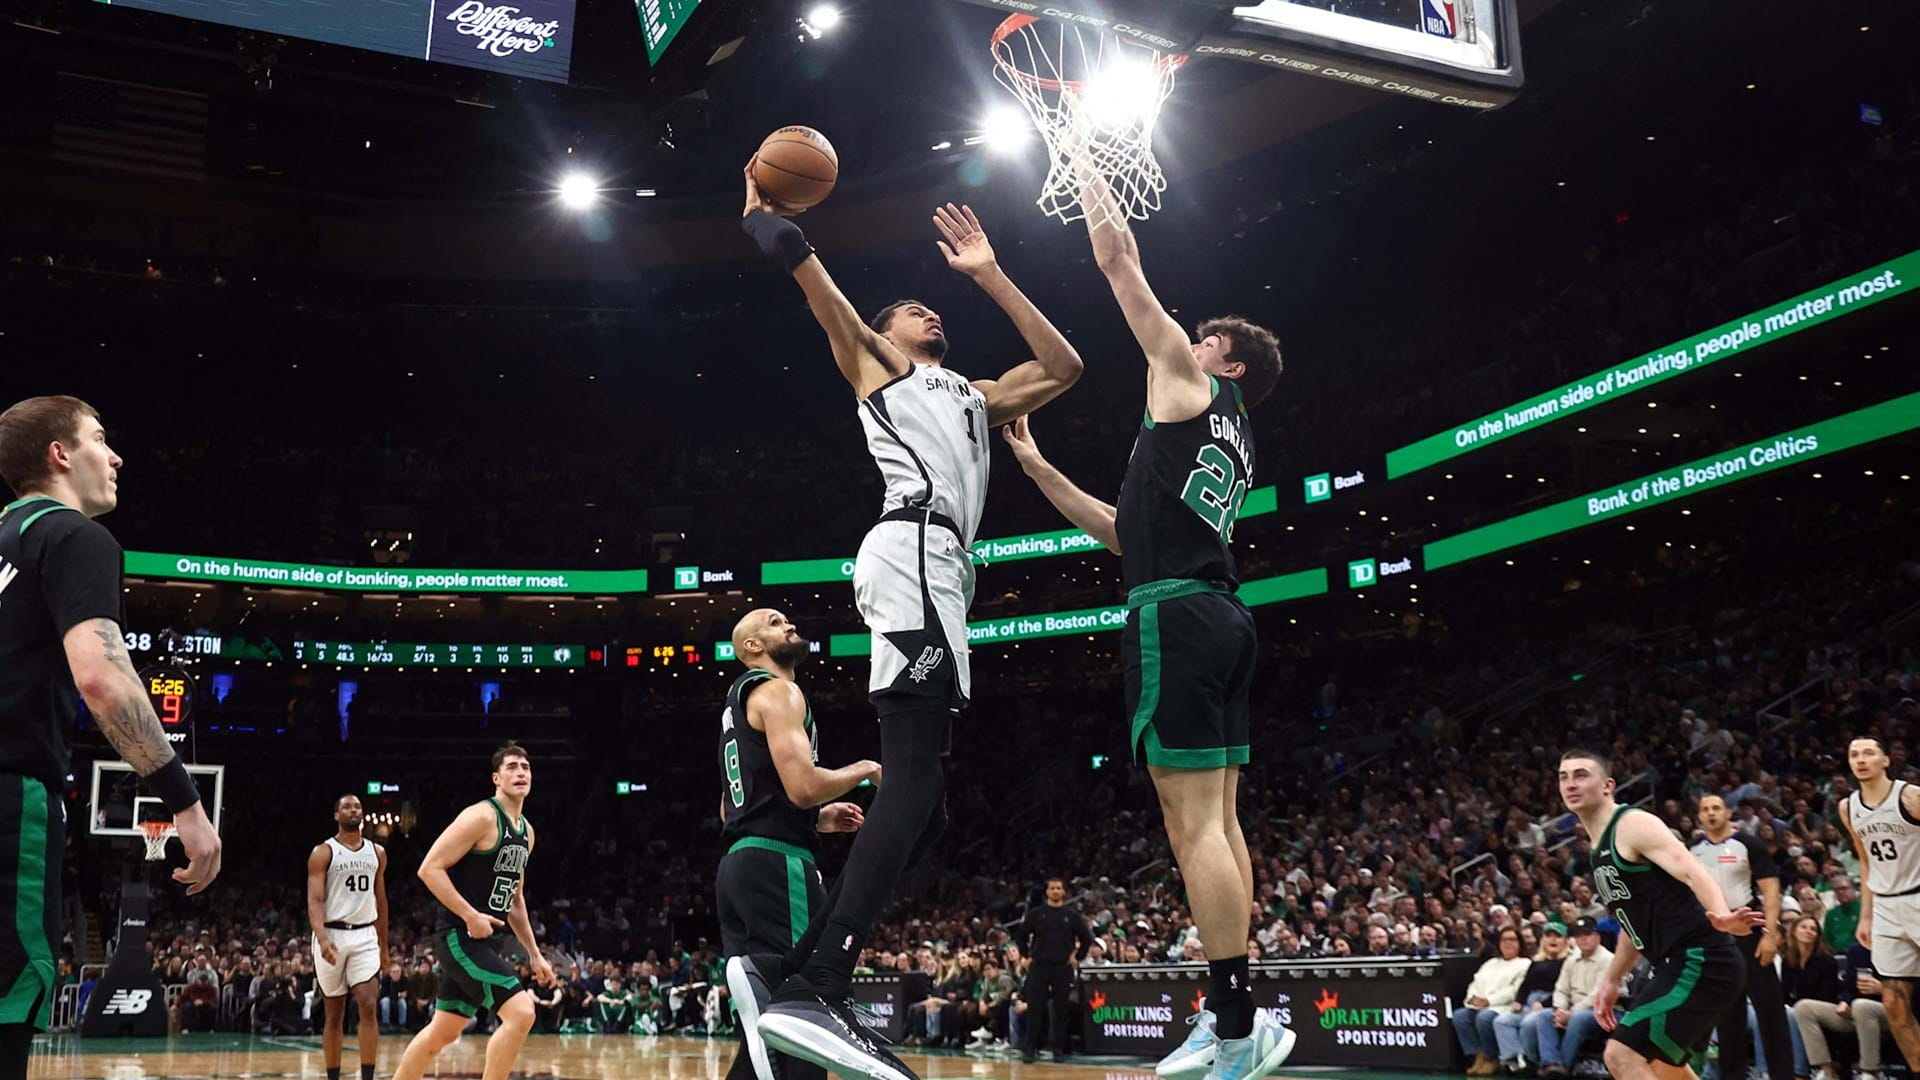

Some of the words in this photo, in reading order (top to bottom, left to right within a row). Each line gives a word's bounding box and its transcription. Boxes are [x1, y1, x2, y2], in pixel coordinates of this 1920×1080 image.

[446, 0, 560, 37] Different
[1427, 17, 1445, 35] NBA
[1113, 24, 1142, 37] C4
[476, 28, 544, 57] Here
[1259, 54, 1286, 65] C4
[1321, 68, 1349, 79] C4
[1455, 429, 1477, 447] On
[1478, 419, 1503, 438] the
[1504, 398, 1558, 430] human
[1560, 385, 1594, 409] side
[1596, 374, 1613, 395] of
[1616, 350, 1693, 388] banking,
[1695, 321, 1761, 362] people
[1765, 294, 1834, 334] matter
[1838, 270, 1901, 306] most.
[964, 407, 977, 445] 1
[1334, 470, 1365, 489] Bank
[1587, 489, 1629, 516] Bank
[1631, 482, 1650, 503] of
[1651, 476, 1681, 497] the
[1683, 455, 1746, 487] Boston
[1749, 434, 1818, 466] Celtics
[976, 542, 991, 558] of
[993, 538, 1058, 557] banking,
[1061, 534, 1099, 550] peop
[177, 558, 201, 574] On
[204, 560, 230, 576] the
[233, 562, 288, 581] human
[291, 567, 323, 583] side
[326, 570, 343, 584] of
[345, 570, 412, 588] banking,
[416, 572, 468, 589] people
[471, 574, 523, 587] matter
[526, 574, 568, 588] most.
[841, 561, 855, 576] O
[1379, 557, 1412, 576] Bank
[677, 570, 697, 585] TD
[703, 569, 733, 583] Bank
[1000, 622, 1015, 636] of
[1018, 620, 1042, 634] the
[1045, 615, 1097, 631] Boston
[366, 652, 393, 663] 16/33
[413, 653, 435, 663] 5/12
[450, 653, 457, 663] 3
[475, 653, 481, 663] 2
[498, 653, 509, 663] 10
[522, 653, 533, 663] 21
[151, 678, 184, 695] 6:26
[162, 695, 181, 723] 9
[724, 738, 744, 808] 9
[1871, 839, 1897, 861] 43
[345, 874, 369, 892] 40
[1093, 1005, 1173, 1024] DRAFTKINGS
[1320, 1007, 1439, 1030] DRAFTKINGS
[1104, 1023, 1164, 1039] SPORTSBOOK
[1336, 1030, 1427, 1047] SPORTSBOOK
